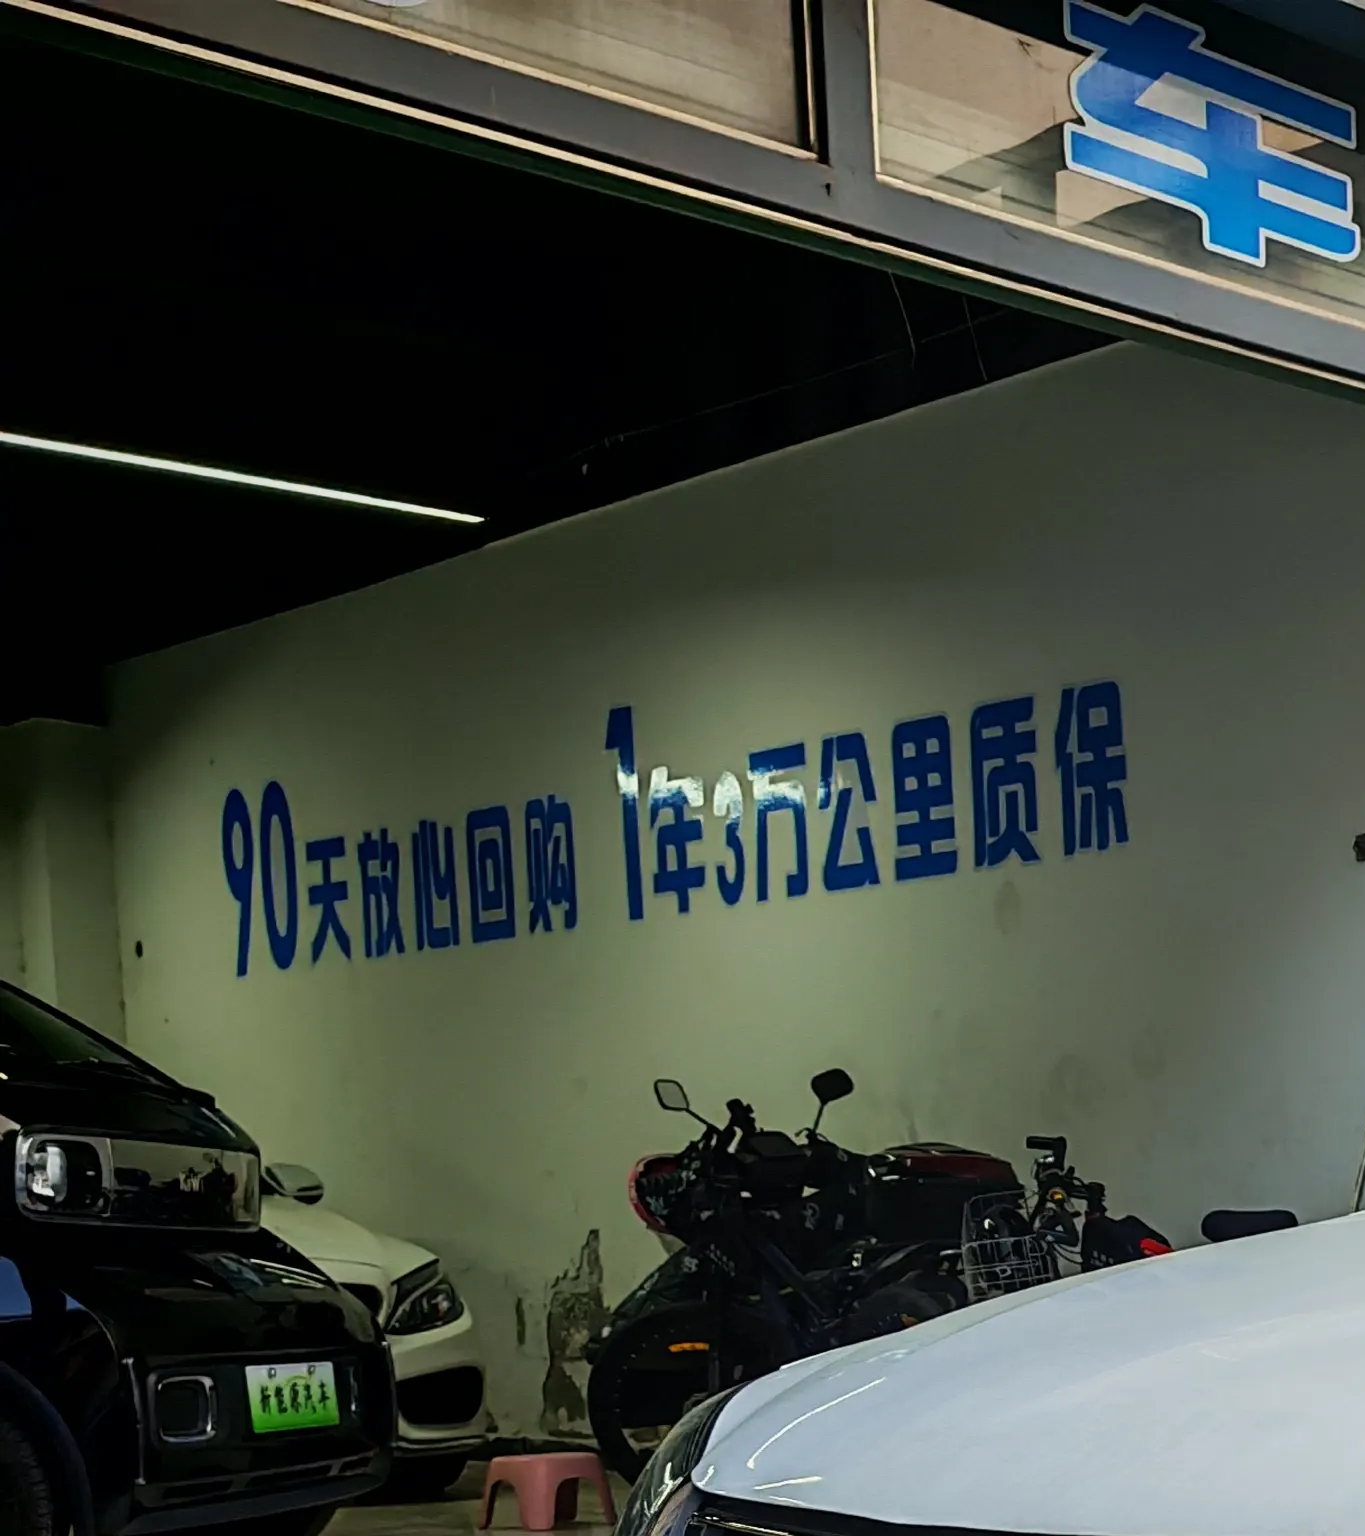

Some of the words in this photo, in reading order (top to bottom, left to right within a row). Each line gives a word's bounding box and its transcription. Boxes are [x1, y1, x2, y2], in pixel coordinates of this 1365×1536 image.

[1064, 0, 1361, 268] 车
[221, 779, 578, 978] 90天放心回购
[602, 679, 1130, 923] 1年3万公里质保
